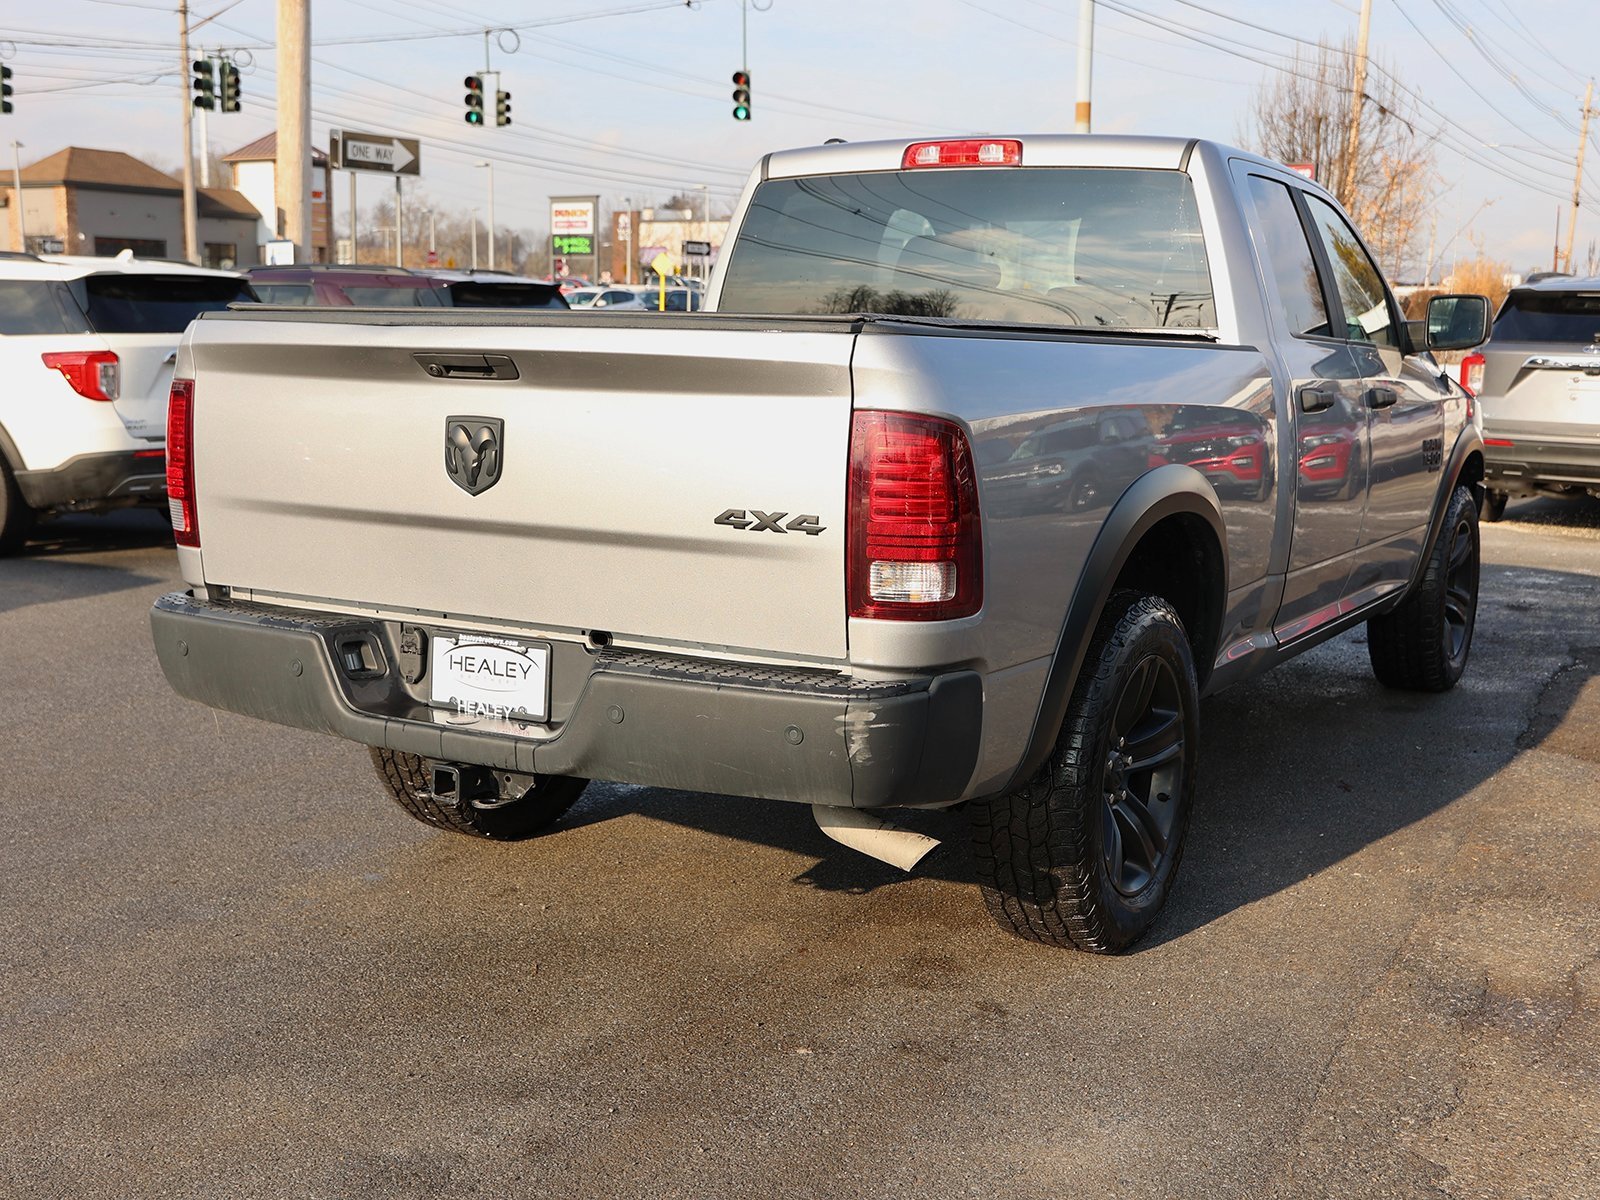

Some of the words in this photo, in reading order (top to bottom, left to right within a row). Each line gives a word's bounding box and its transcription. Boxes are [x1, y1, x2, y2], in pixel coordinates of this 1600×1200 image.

[352, 144, 371, 159] ONE
[375, 147, 394, 161] WAY
[713, 508, 828, 536] 4X4
[449, 654, 532, 680] HEALEY
[457, 700, 514, 721] HEALEY
